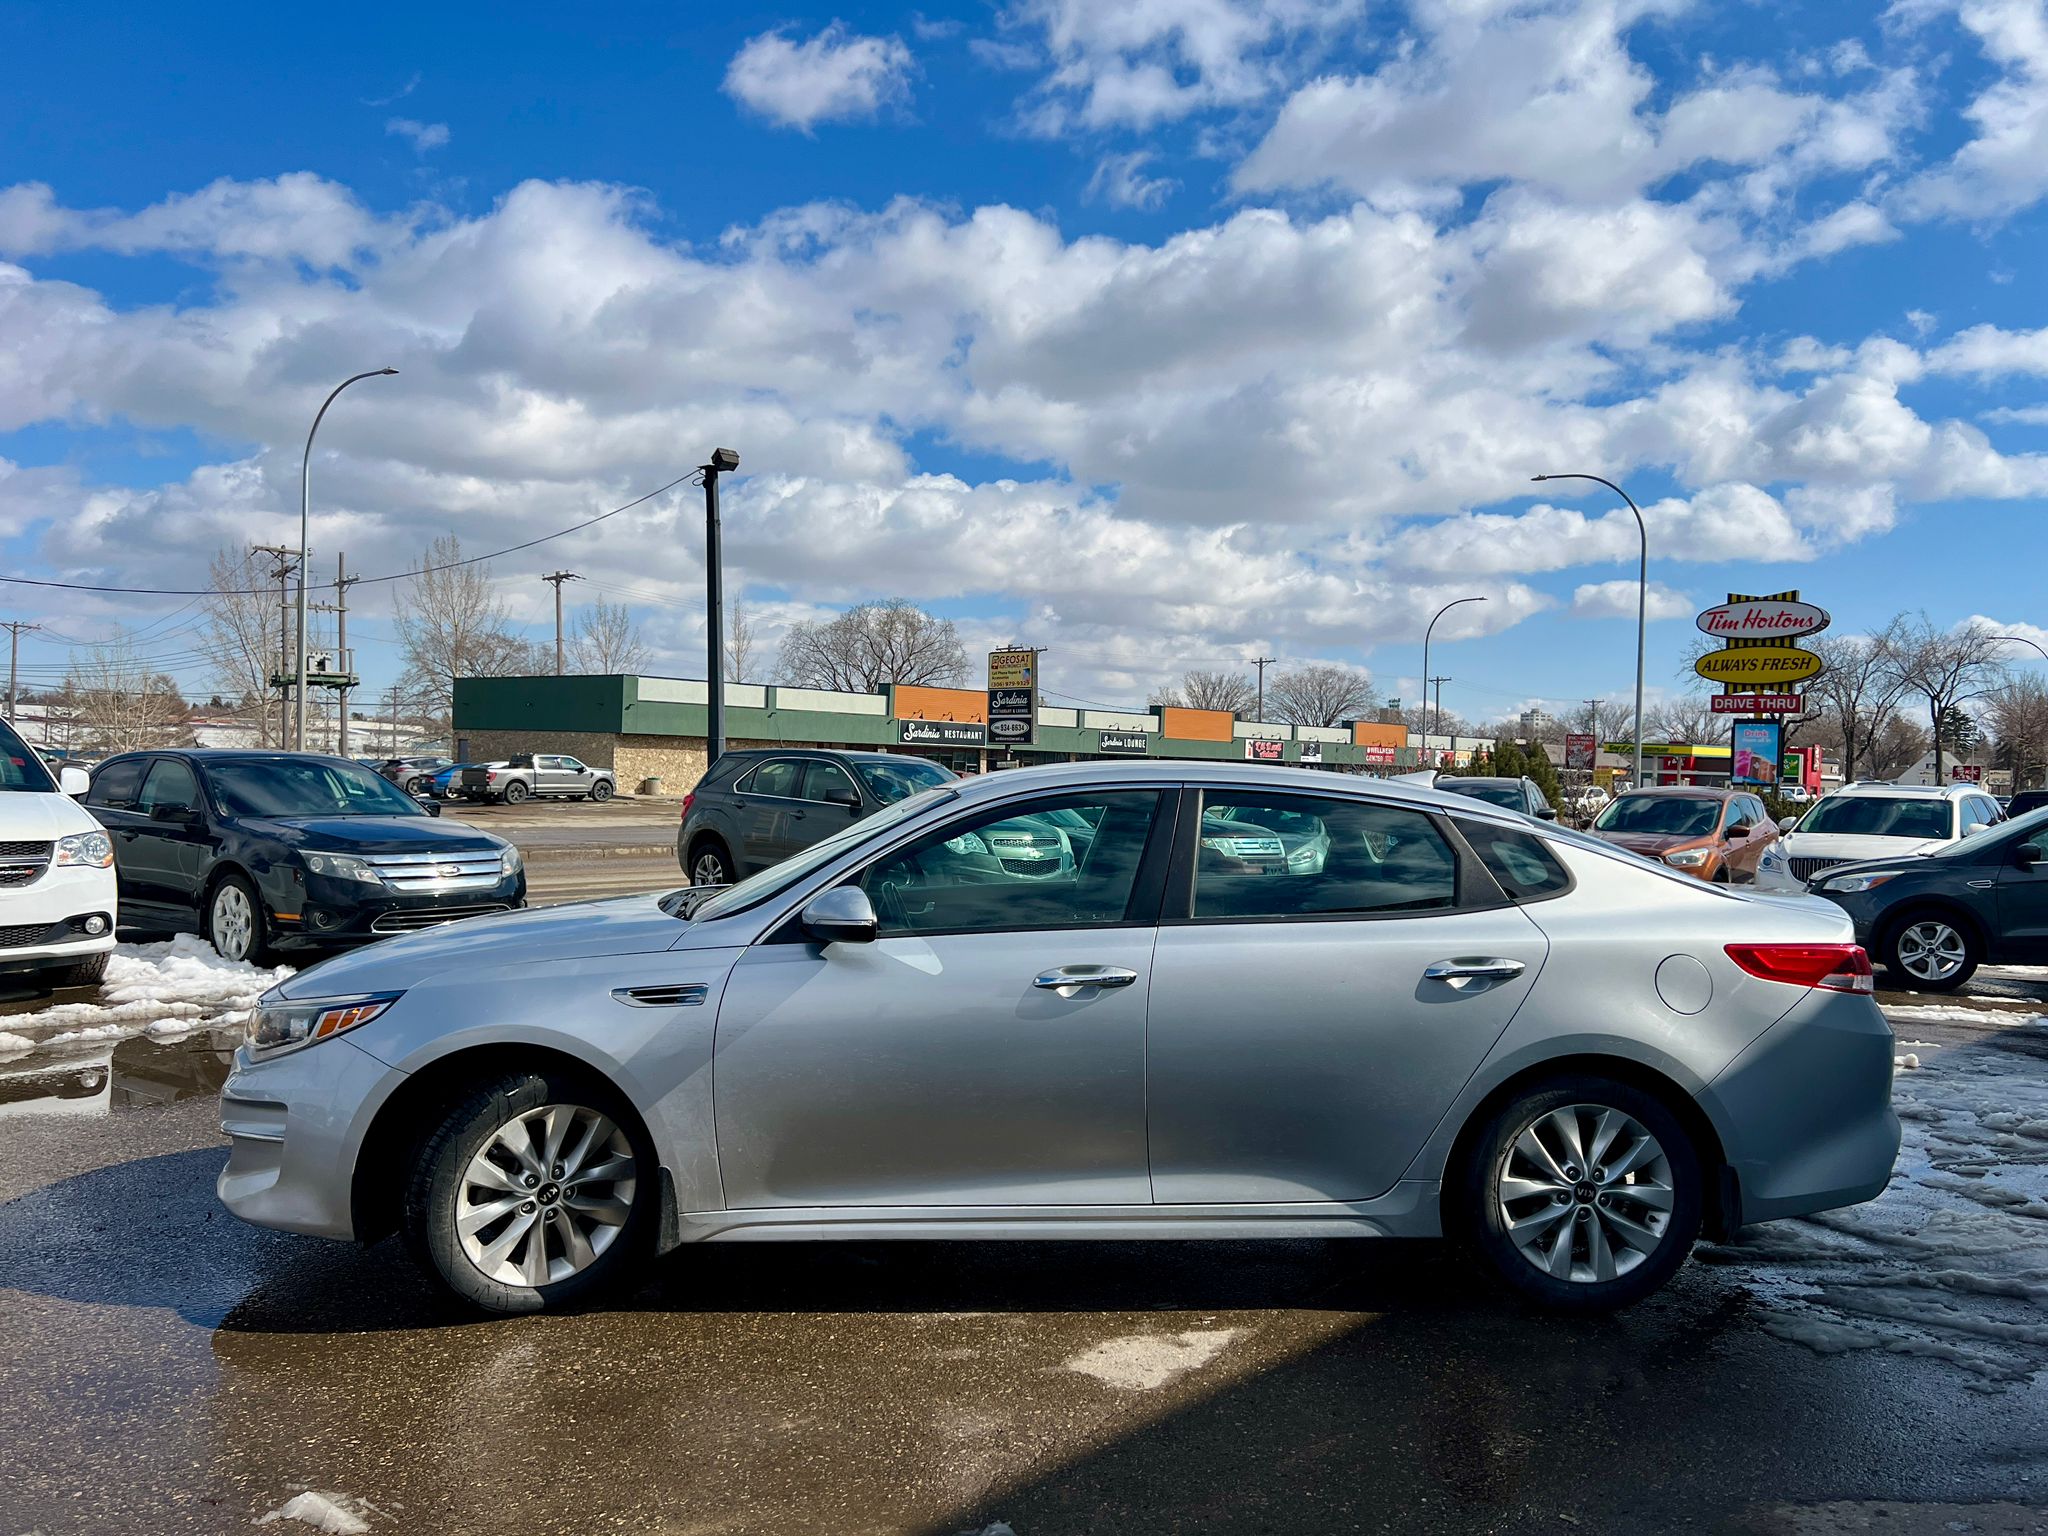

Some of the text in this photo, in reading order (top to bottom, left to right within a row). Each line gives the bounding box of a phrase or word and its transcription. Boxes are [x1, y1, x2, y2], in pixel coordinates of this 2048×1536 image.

[1706, 608, 1813, 631] Tim Hortons
[999, 654, 1030, 665] GEOSAT
[1702, 657, 1813, 672] ALWAYS FRESH
[992, 691, 1028, 708] Sardinia
[1714, 698, 1796, 709] DRIVE THRU
[903, 722, 982, 741] Sardinia RESTAURANT
[1123, 738, 1146, 748] LOUNGE
[539, 1186, 559, 1203] KIA
[1577, 1187, 1595, 1199] KIA
